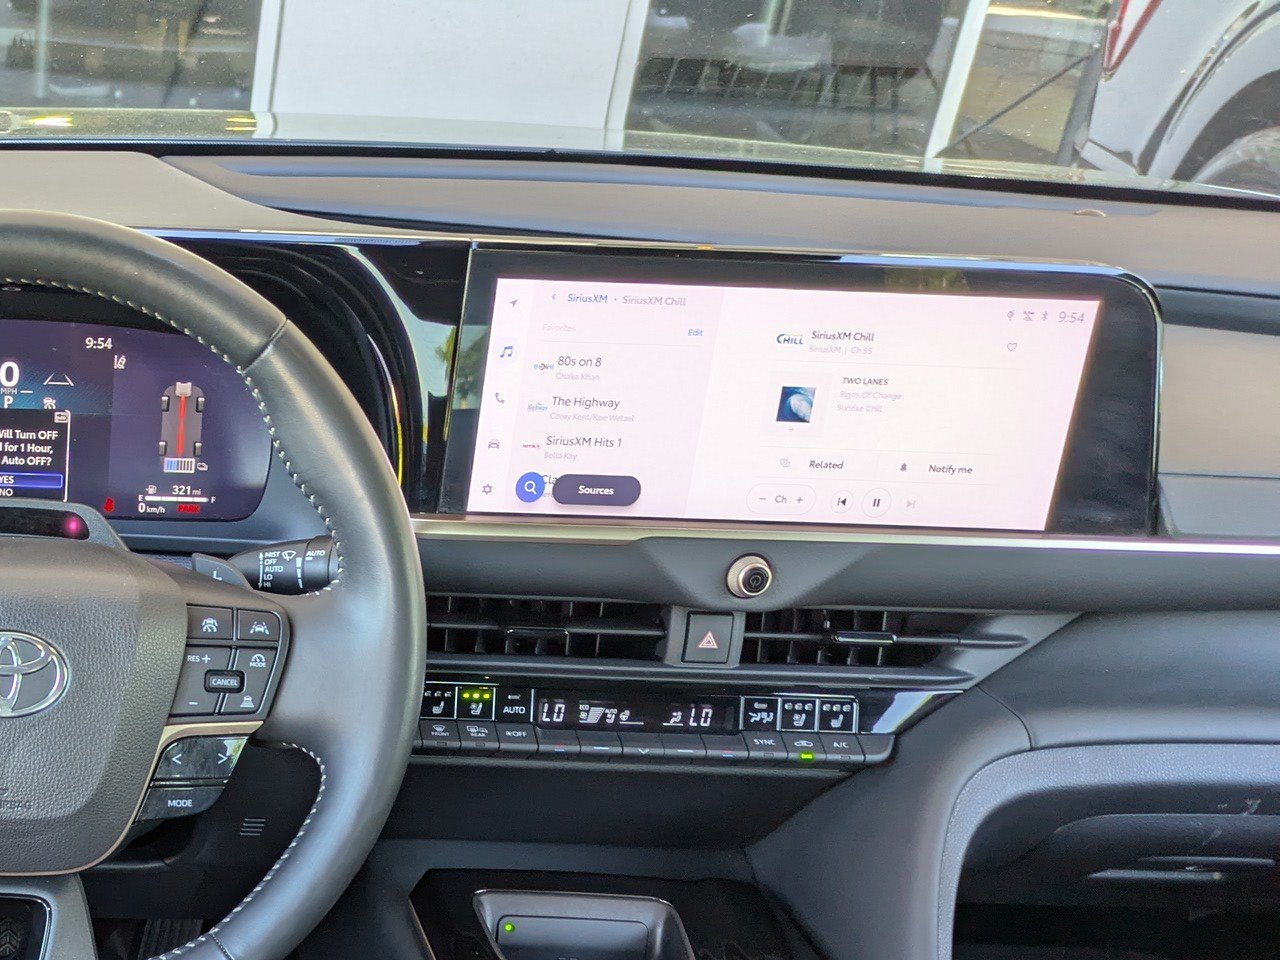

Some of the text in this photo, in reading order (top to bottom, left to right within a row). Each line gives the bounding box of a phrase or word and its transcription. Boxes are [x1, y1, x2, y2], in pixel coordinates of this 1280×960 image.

[567, 293, 686, 307] SiriusXM SiriusXM Chill
[1058, 311, 1085, 324] 9:54
[687, 328, 703, 337] Edit
[811, 331, 875, 342] SiriusXM Chill
[85, 338, 112, 349] 9:54
[808, 345, 842, 355] SiriusXM
[557, 356, 577, 367] 80s
[579, 359, 594, 367] on
[595, 357, 602, 367] 8
[0, 361, 20, 387] 0
[555, 372, 600, 382] Chaka Khan
[842, 377, 888, 386] TWO LANES
[0, 387, 17, 395] MPH
[4, 396, 13, 408] P
[552, 396, 620, 410] The Highway
[15, 430, 36, 440] Turn
[38, 430, 59, 440] OFF
[546, 436, 591, 448] SiriusXM
[594, 437, 615, 448] Hits
[4, 443, 18, 452] for
[27, 444, 54, 455] Hour,
[2, 455, 25, 465] Auto
[27, 456, 52, 466] OFF?
[809, 460, 844, 470] Related
[929, 464, 955, 476] Notify
[172, 486, 202, 495] 321 mi
[578, 485, 614, 496] Sources
[210, 496, 216, 504] F
[775, 494, 787, 504] Ch
[138, 503, 166, 514] 0 km/h
[177, 504, 200, 513] PARK
[265, 558, 277, 566] OFF
[265, 565, 284, 573] AUTO
[264, 573, 273, 581] LO
[187, 654, 200, 663] RES
[212, 678, 238, 687] CANCEL
[503, 705, 526, 714] AUTO
[753, 738, 776, 746] SYNC
[833, 741, 849, 749] A/C
[168, 799, 193, 808] MODE
